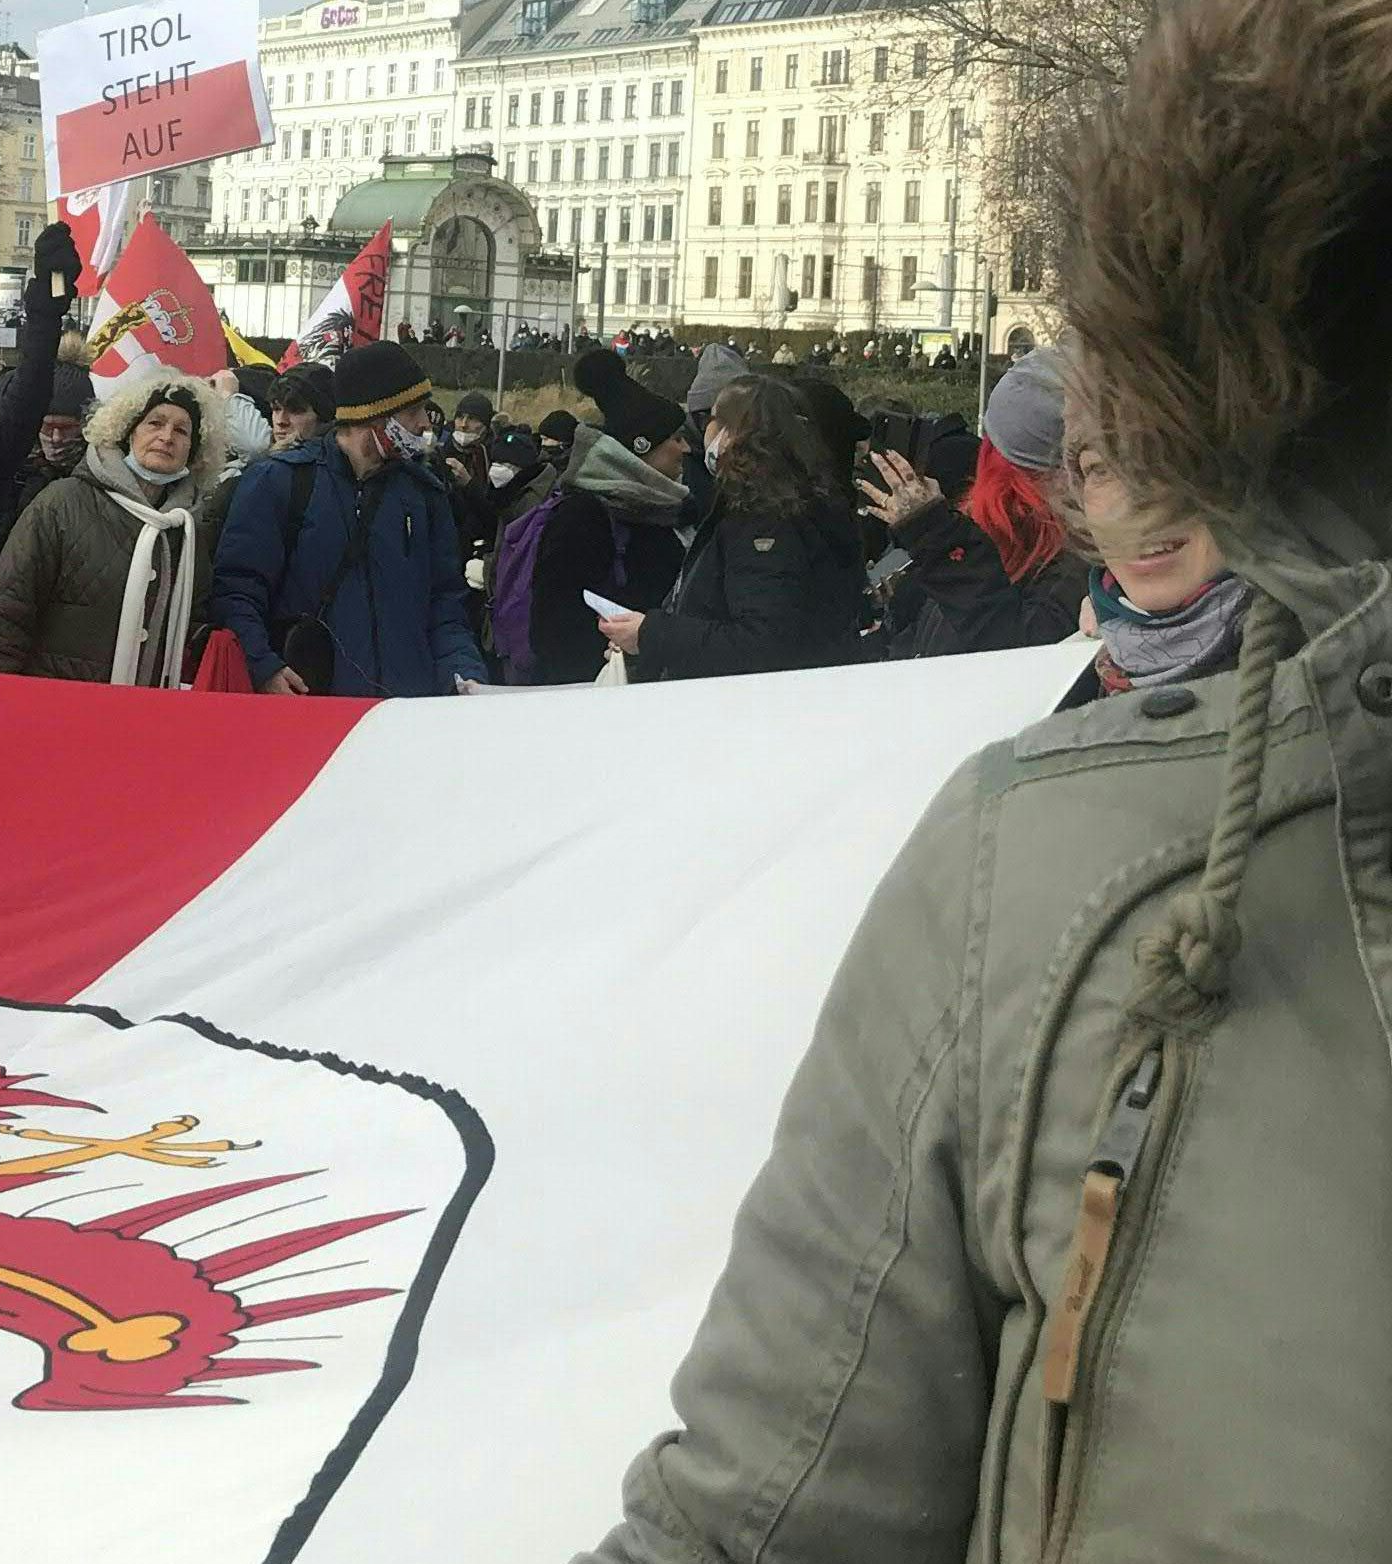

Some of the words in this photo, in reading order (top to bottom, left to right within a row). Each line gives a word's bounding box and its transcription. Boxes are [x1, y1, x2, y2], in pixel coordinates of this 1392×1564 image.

[99, 13, 191, 61] TIROL
[102, 60, 196, 115] STEHT
[122, 118, 183, 164] AUF
